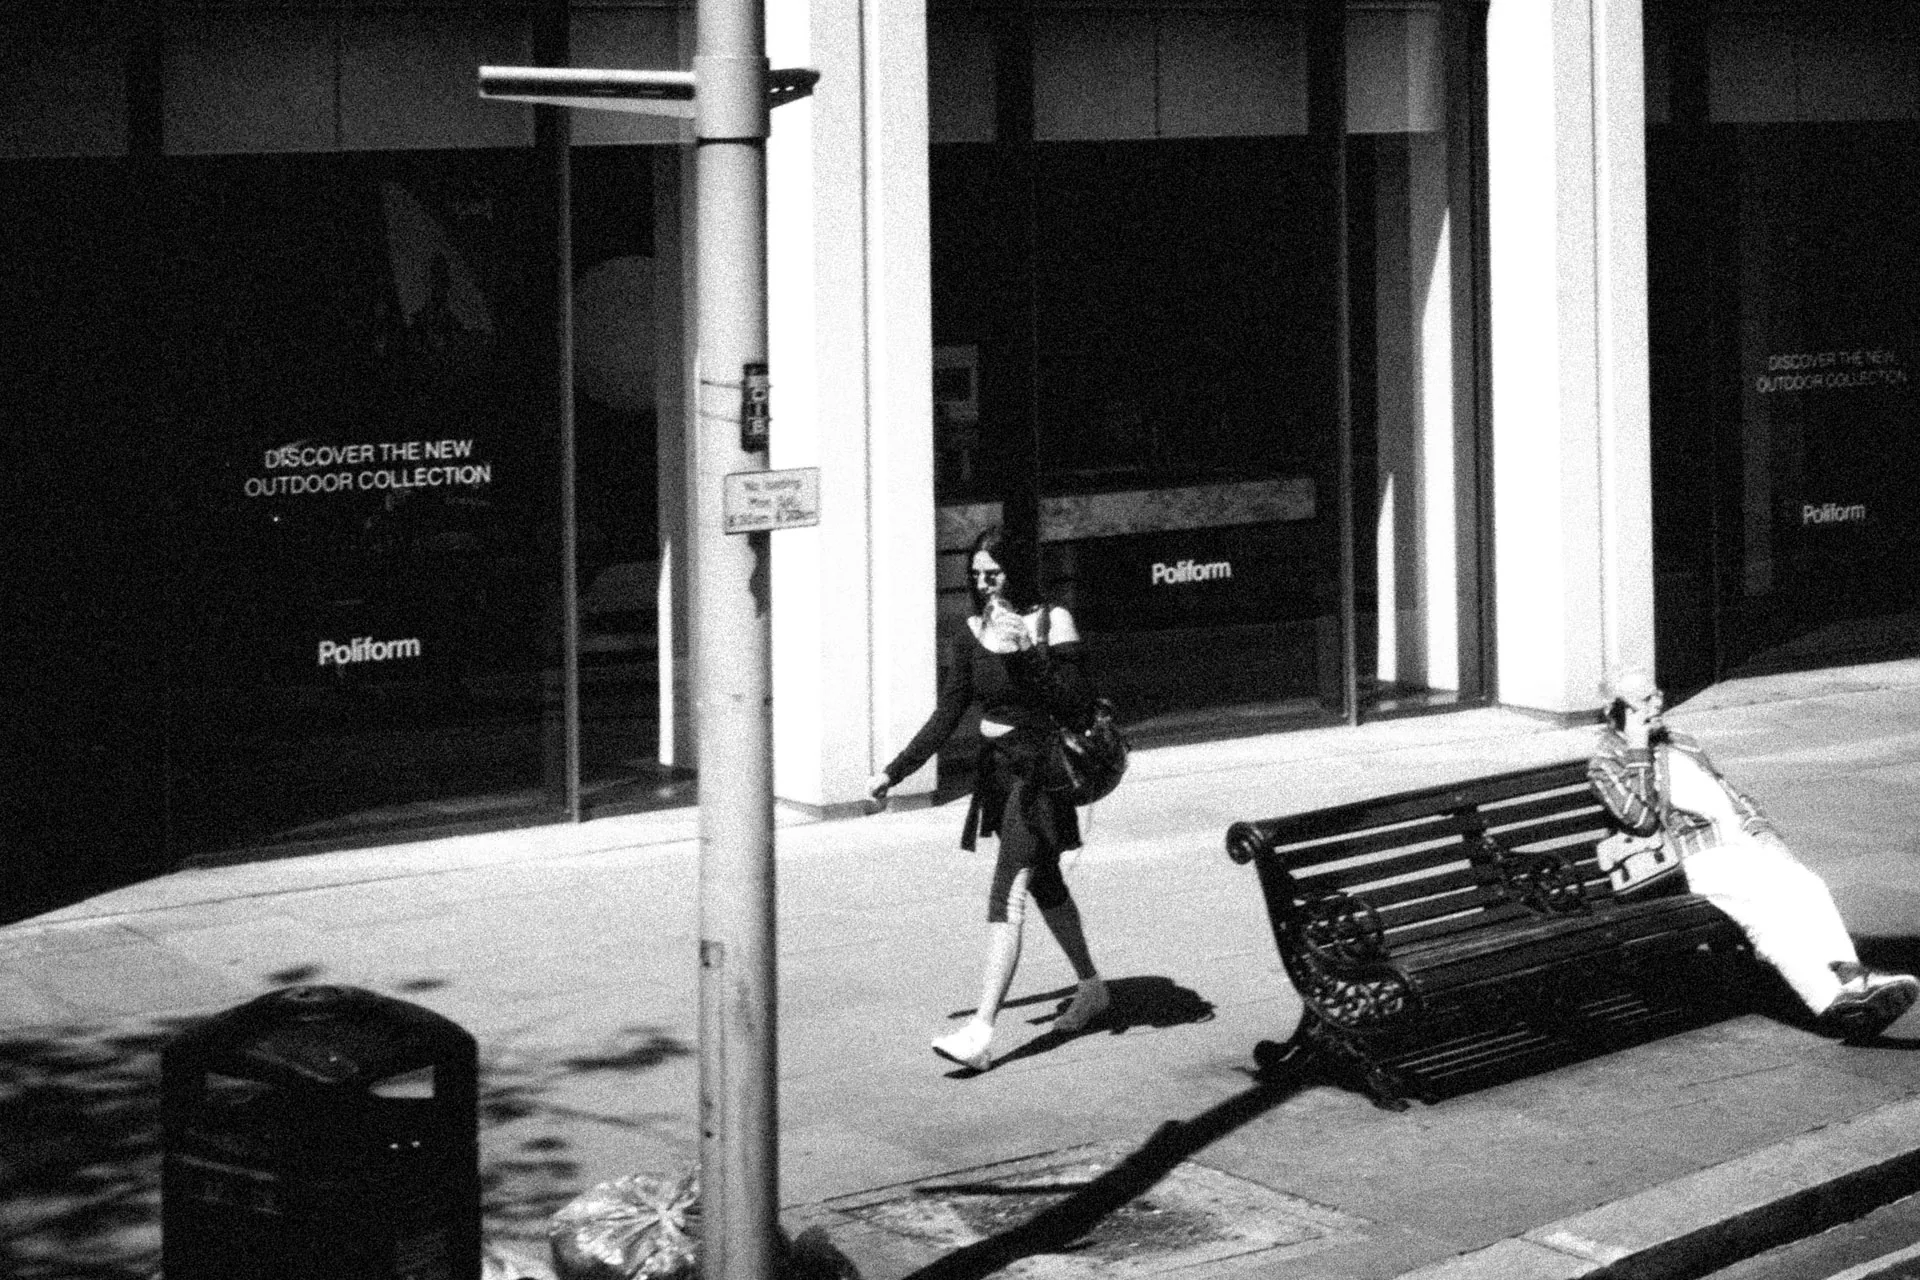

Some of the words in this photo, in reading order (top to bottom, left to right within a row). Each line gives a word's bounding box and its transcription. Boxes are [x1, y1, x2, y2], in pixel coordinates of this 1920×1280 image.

[265, 444, 375, 469] DISCOVER
[379, 441, 420, 461] THE
[424, 439, 473, 459] NEW
[244, 472, 353, 497] OUTDOOR
[358, 465, 491, 491] COLLECTION
[1803, 502, 1866, 525] Poliform
[1151, 558, 1231, 586] Poliform
[318, 635, 421, 666] Poliform
